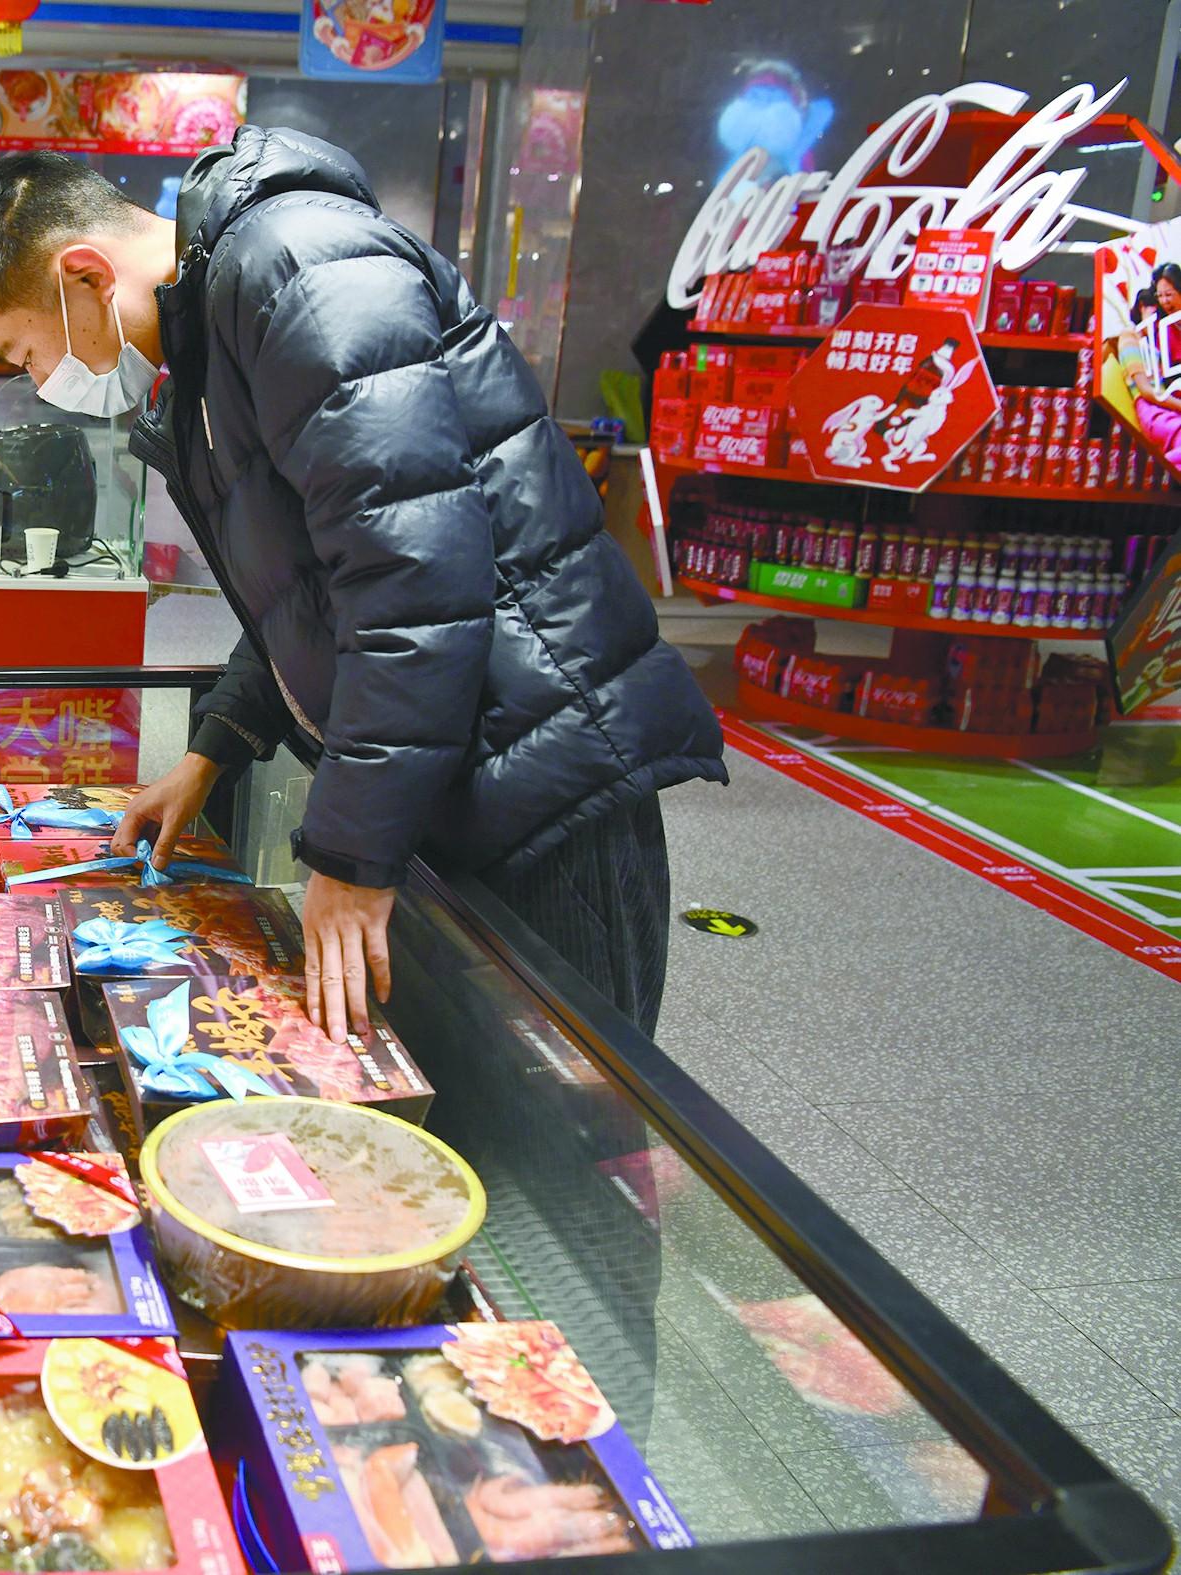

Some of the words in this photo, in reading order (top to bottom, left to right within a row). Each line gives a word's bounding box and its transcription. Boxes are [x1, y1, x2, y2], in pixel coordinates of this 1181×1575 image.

[667, 76, 1129, 310] Coca-Cola
[830, 330, 919, 354] 即刻开启
[826, 350, 914, 375] 畅爽好年
[0, 697, 116, 752] 大嘴
